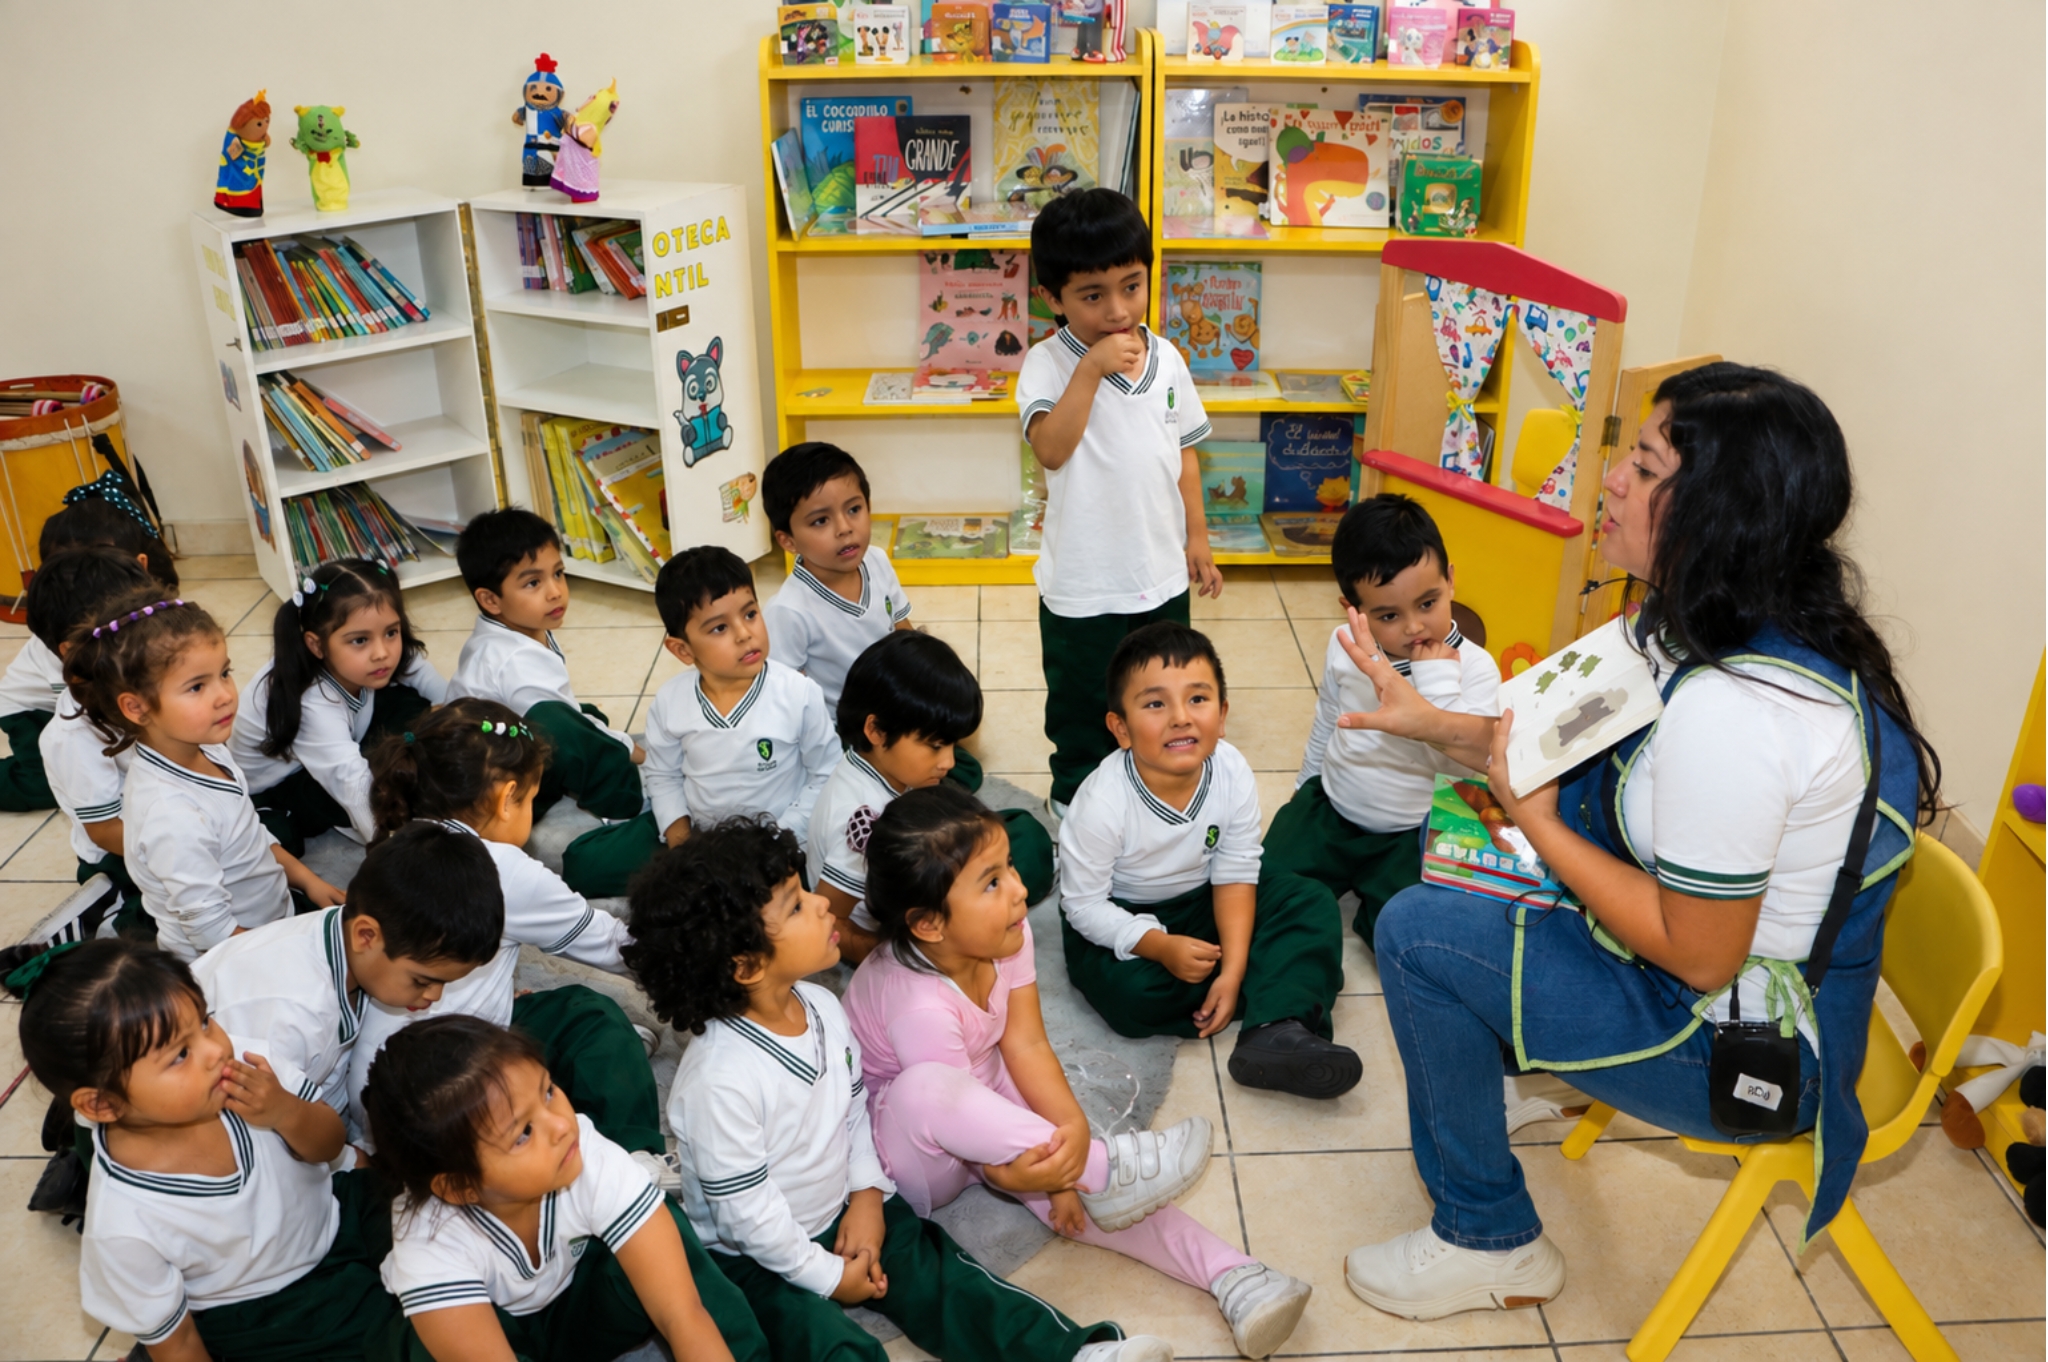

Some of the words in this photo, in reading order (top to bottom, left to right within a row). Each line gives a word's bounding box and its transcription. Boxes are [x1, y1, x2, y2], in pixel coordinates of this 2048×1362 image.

[905, 139, 960, 171] GRANDE
[652, 215, 731, 257] OTECA
[654, 262, 709, 299] NTIL
